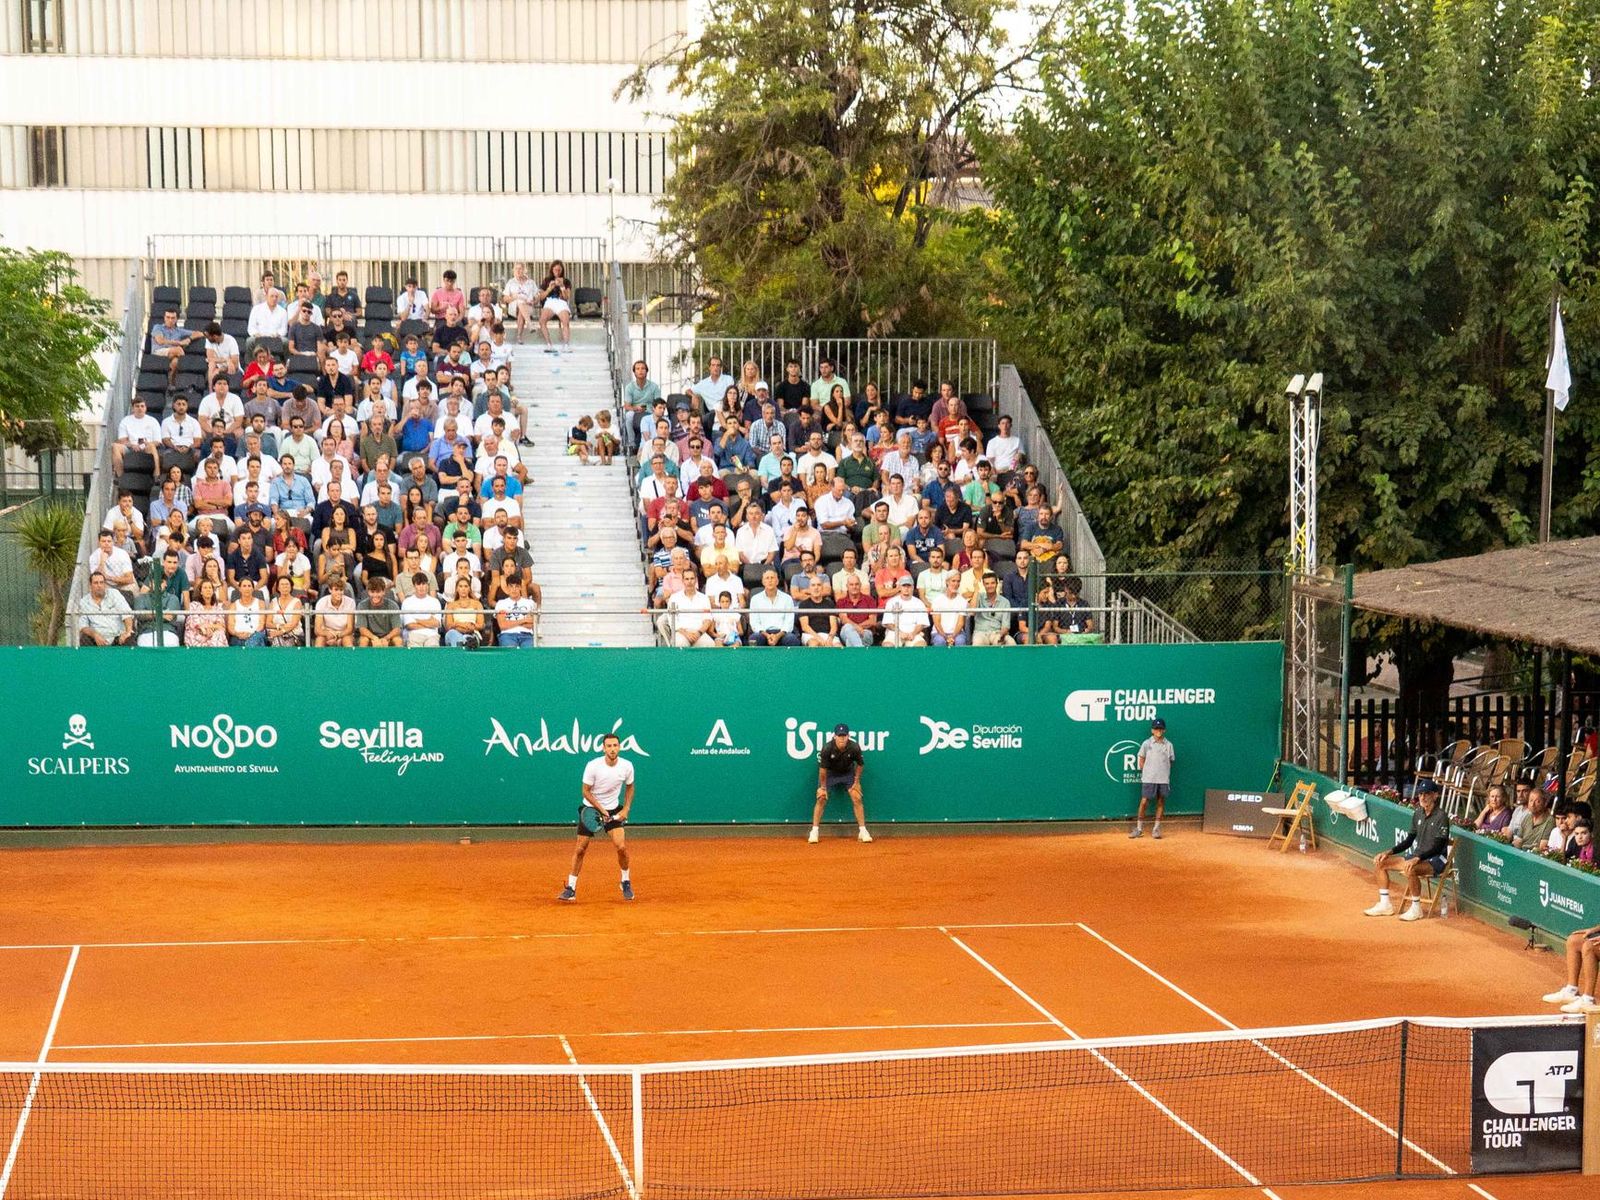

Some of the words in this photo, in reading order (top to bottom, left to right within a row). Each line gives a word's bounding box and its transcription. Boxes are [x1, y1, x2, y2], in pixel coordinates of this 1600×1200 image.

[1114, 688, 1215, 705] CHALLENGER
[1115, 706, 1156, 721] TOUR
[319, 720, 423, 749] Sevilla
[972, 734, 1022, 749] Sevilla
[28, 757, 130, 775] SCALPERS
[1227, 793, 1263, 803] SPEED
[1549, 892, 1566, 907] JUAN
[1565, 898, 1585, 915] FERIA
[1545, 1065, 1574, 1076] ATP
[1483, 1115, 1576, 1134] CHALLENGER
[1483, 1133, 1522, 1149] TOUR
